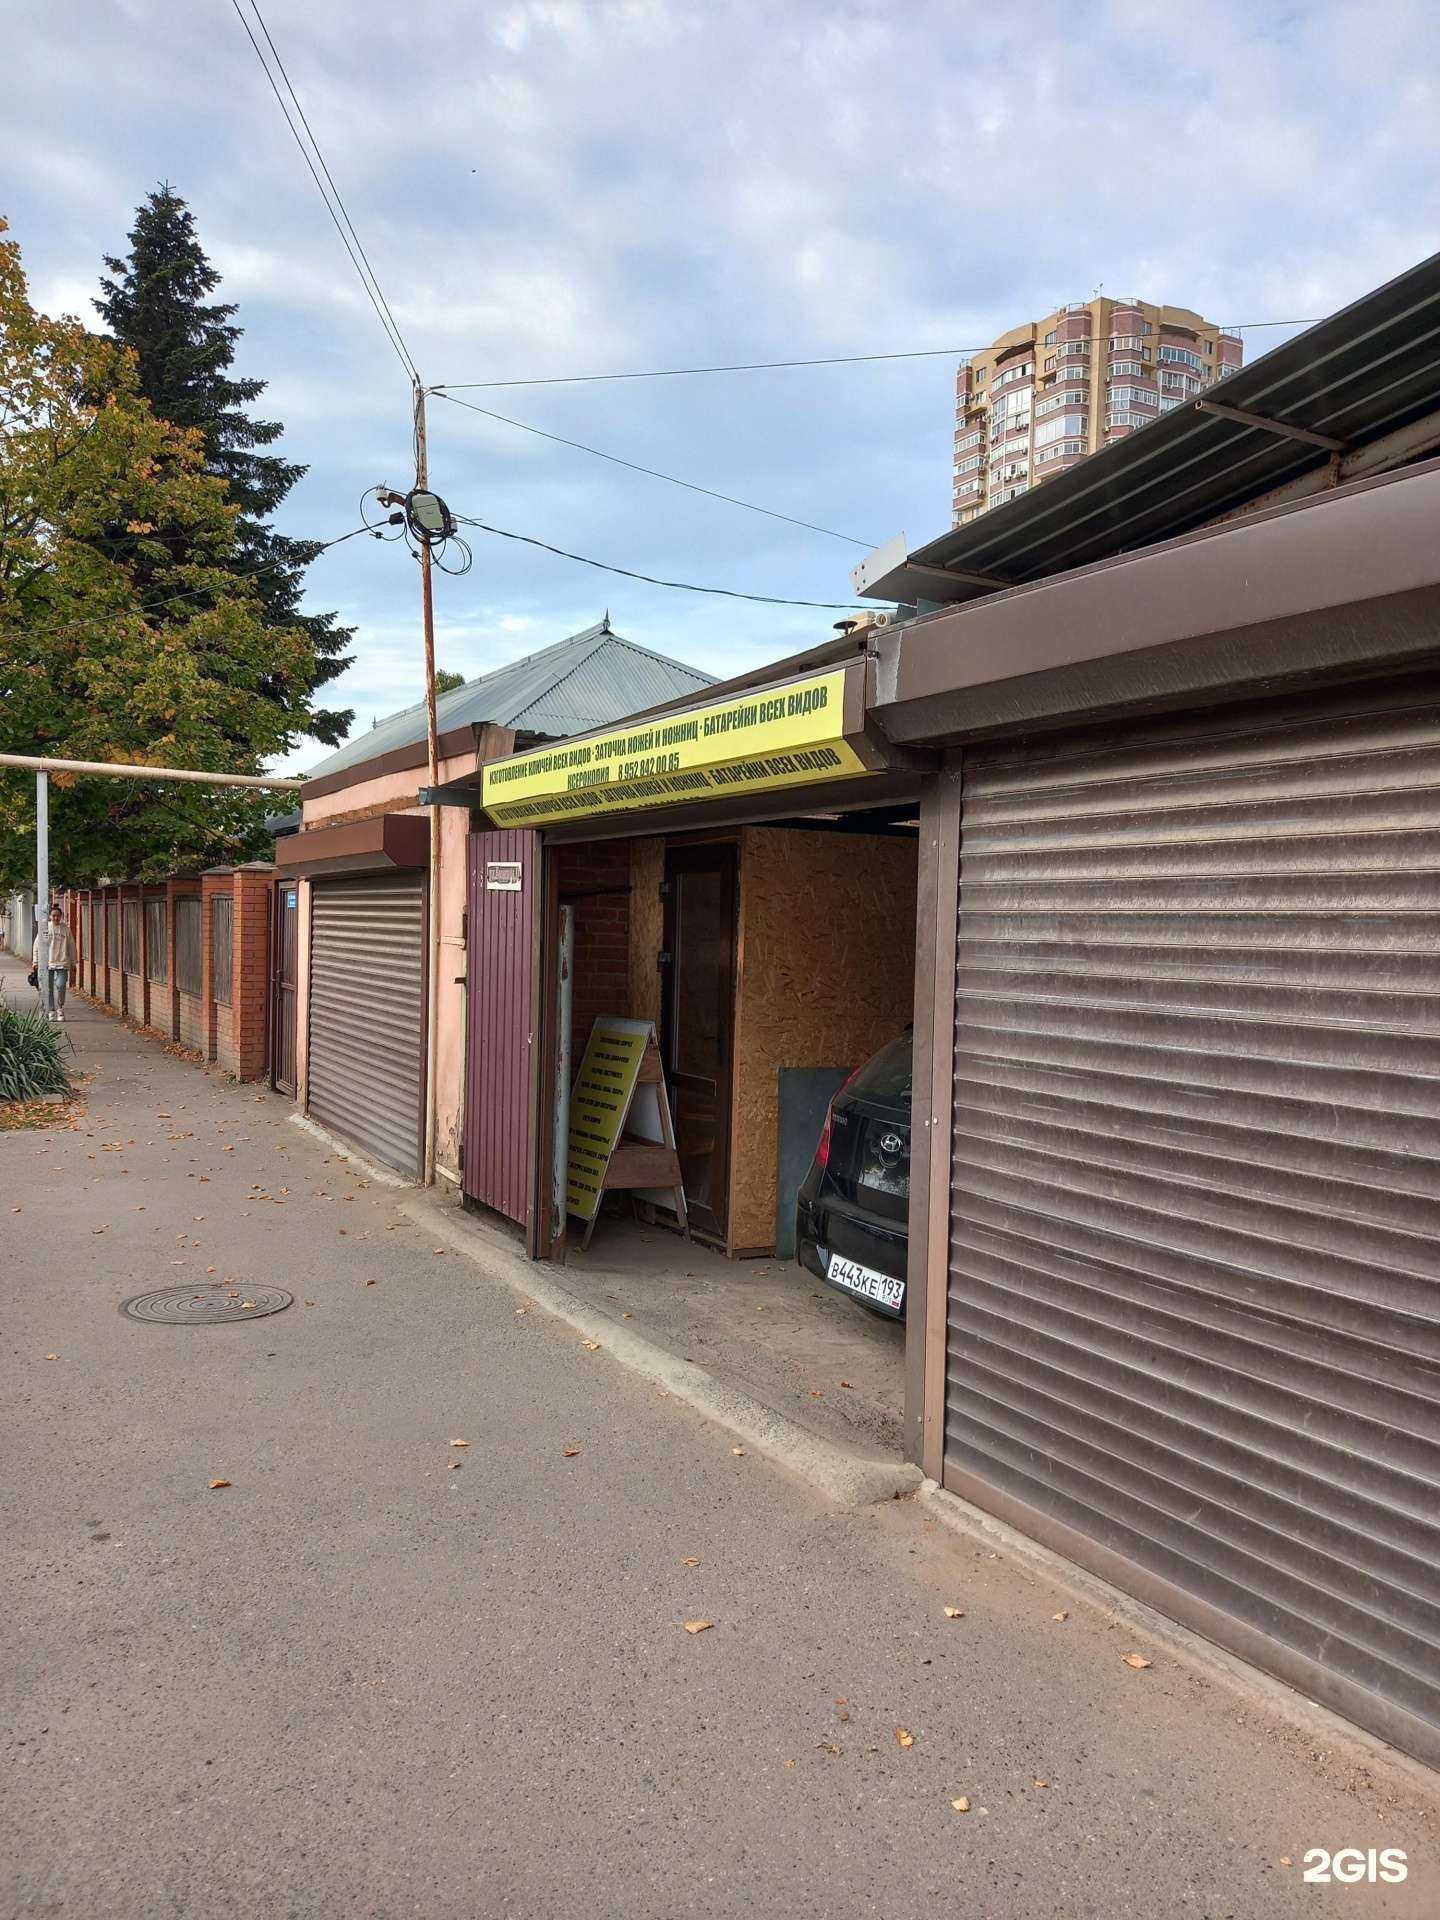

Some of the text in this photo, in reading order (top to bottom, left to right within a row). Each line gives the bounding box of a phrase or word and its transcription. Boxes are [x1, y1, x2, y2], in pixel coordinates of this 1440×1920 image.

[553, 752, 568, 771] ВСЕХ
[569, 746, 591, 768] ВИДОВ
[595, 738, 626, 761] ЗАТОЧКА
[627, 728, 654, 755] НОЖЕЙ
[655, 729, 661, 748] И
[661, 720, 698, 747] НОЖНИЦ
[703, 705, 758, 737] БАТАРЕЙКИ
[759, 697, 786, 723] ВСЕХ
[787, 686, 828, 717] ВИДОВ
[618, 764, 624, 781] 8
[624, 761, 639, 780] 952
[639, 757, 655, 777] 842
[656, 755, 667, 774] 00
[668, 752, 680, 771] 85
[708, 760, 770, 785] БАТАРЕЙКИ
[764, 754, 799, 776] ВСЕХ
[794, 747, 842, 771] ВИДОВ
[882, 1278, 902, 1299] 193
